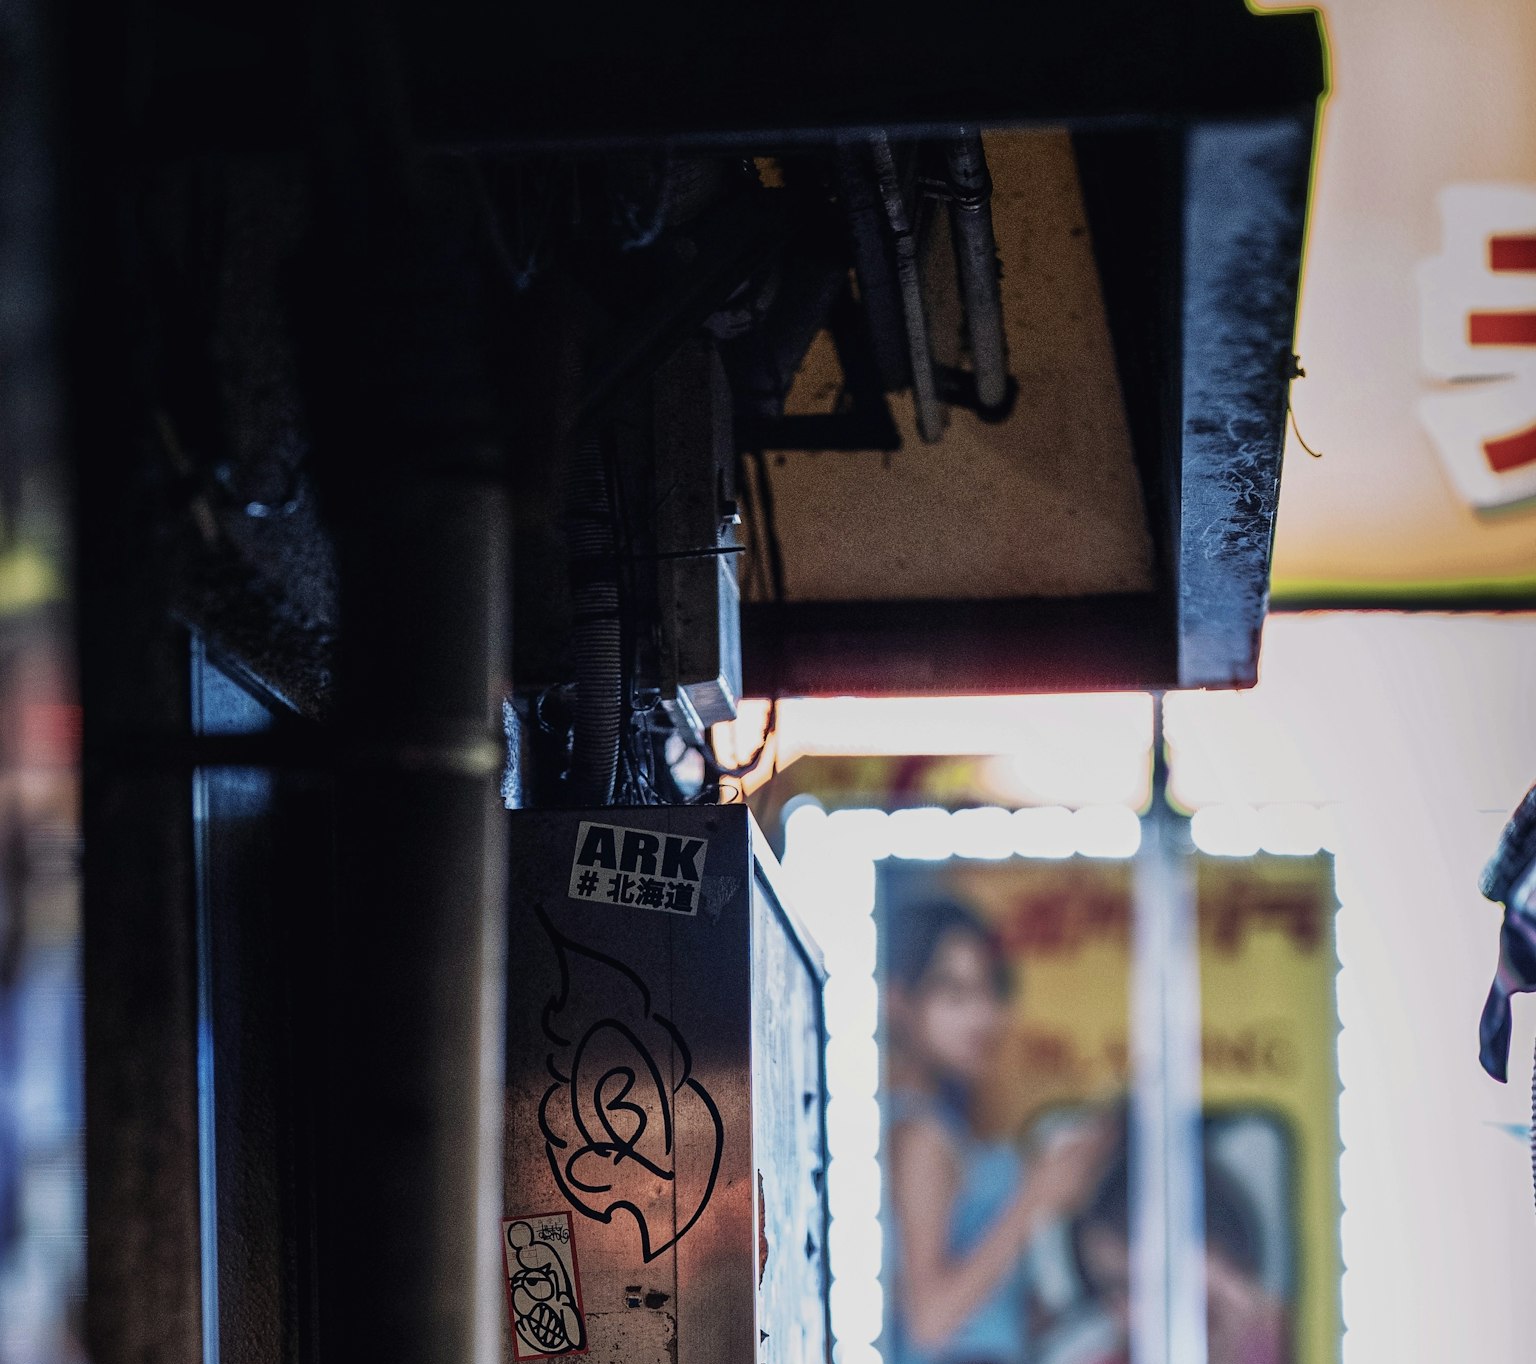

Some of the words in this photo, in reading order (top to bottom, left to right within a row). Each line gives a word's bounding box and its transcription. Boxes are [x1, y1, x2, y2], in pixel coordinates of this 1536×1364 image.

[577, 826, 704, 881] ARK
[577, 870, 695, 912] #北海道
